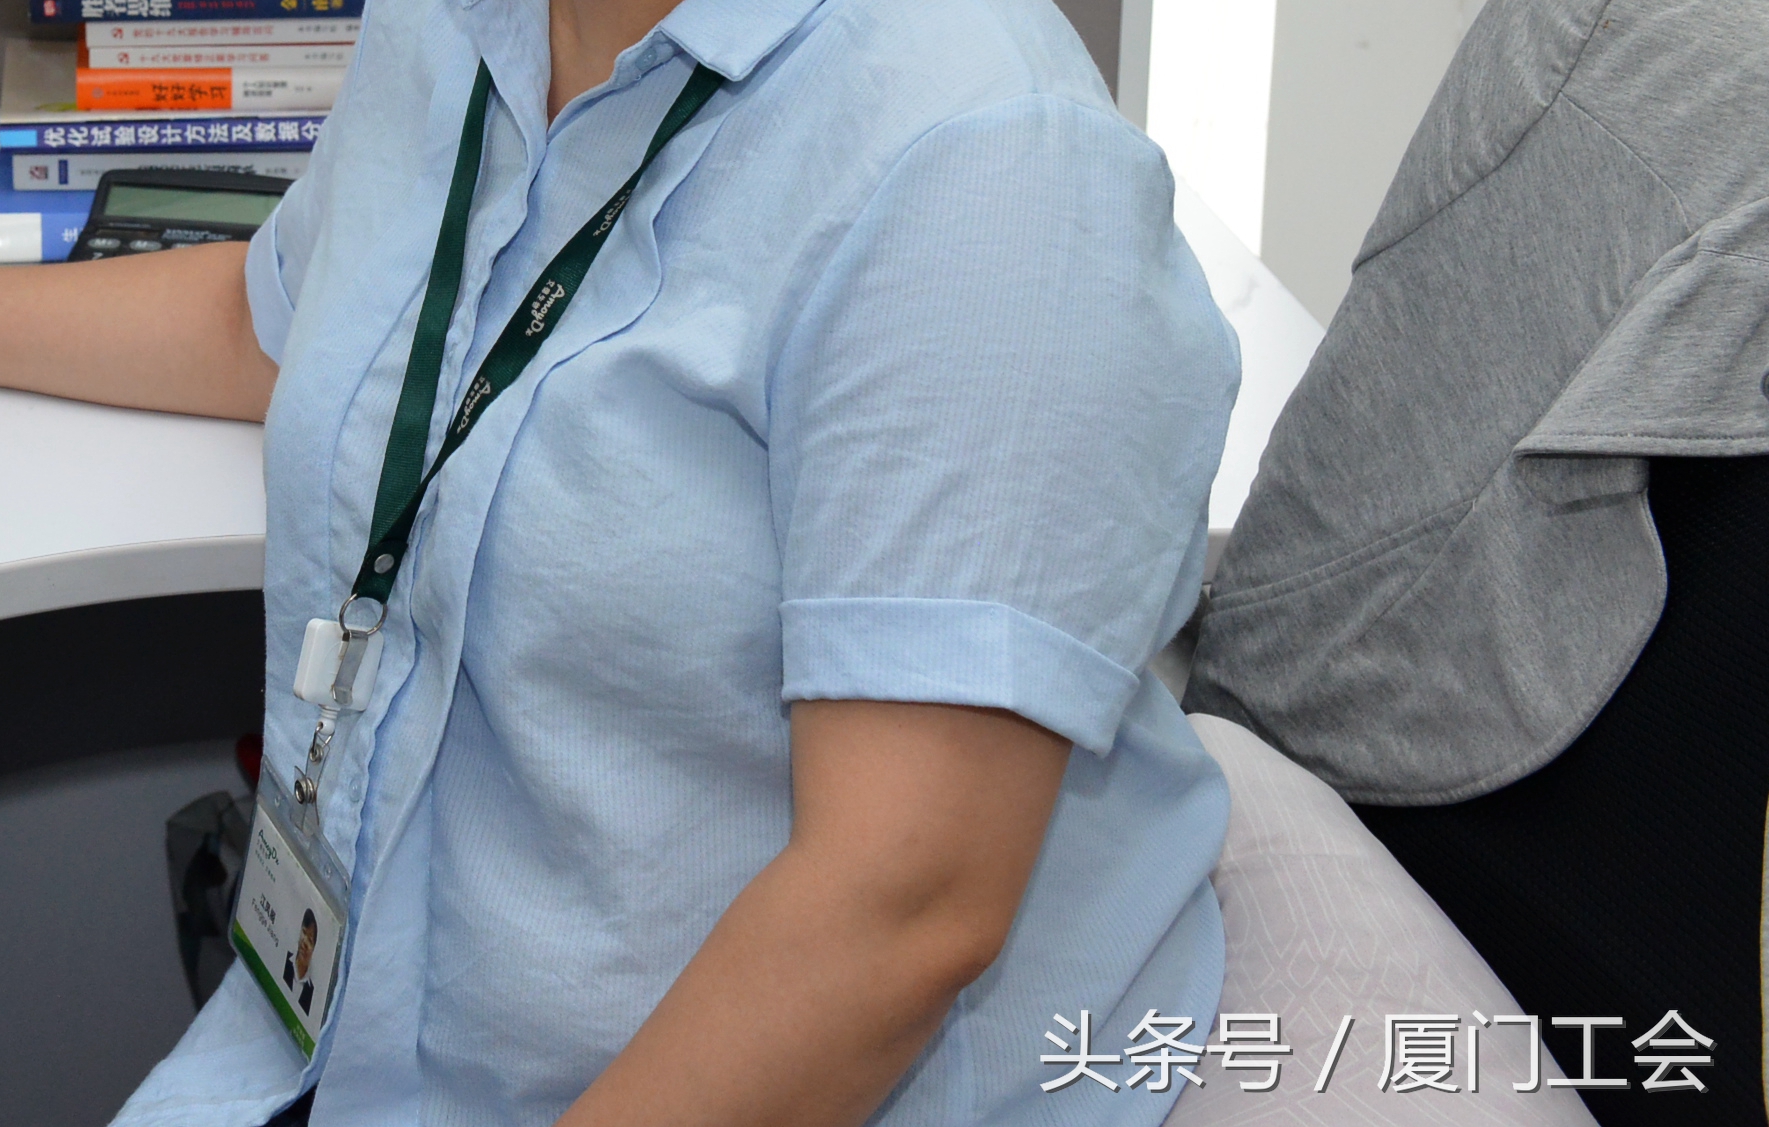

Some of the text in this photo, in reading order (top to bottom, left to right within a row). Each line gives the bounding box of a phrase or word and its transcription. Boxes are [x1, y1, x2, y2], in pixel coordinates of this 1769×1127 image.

[152, 82, 227, 102] 好好学习
[43, 121, 322, 148] 优化试验设计方法及数据分
[525, 283, 565, 337] AmoyDx
[456, 380, 492, 435] AmoyDx
